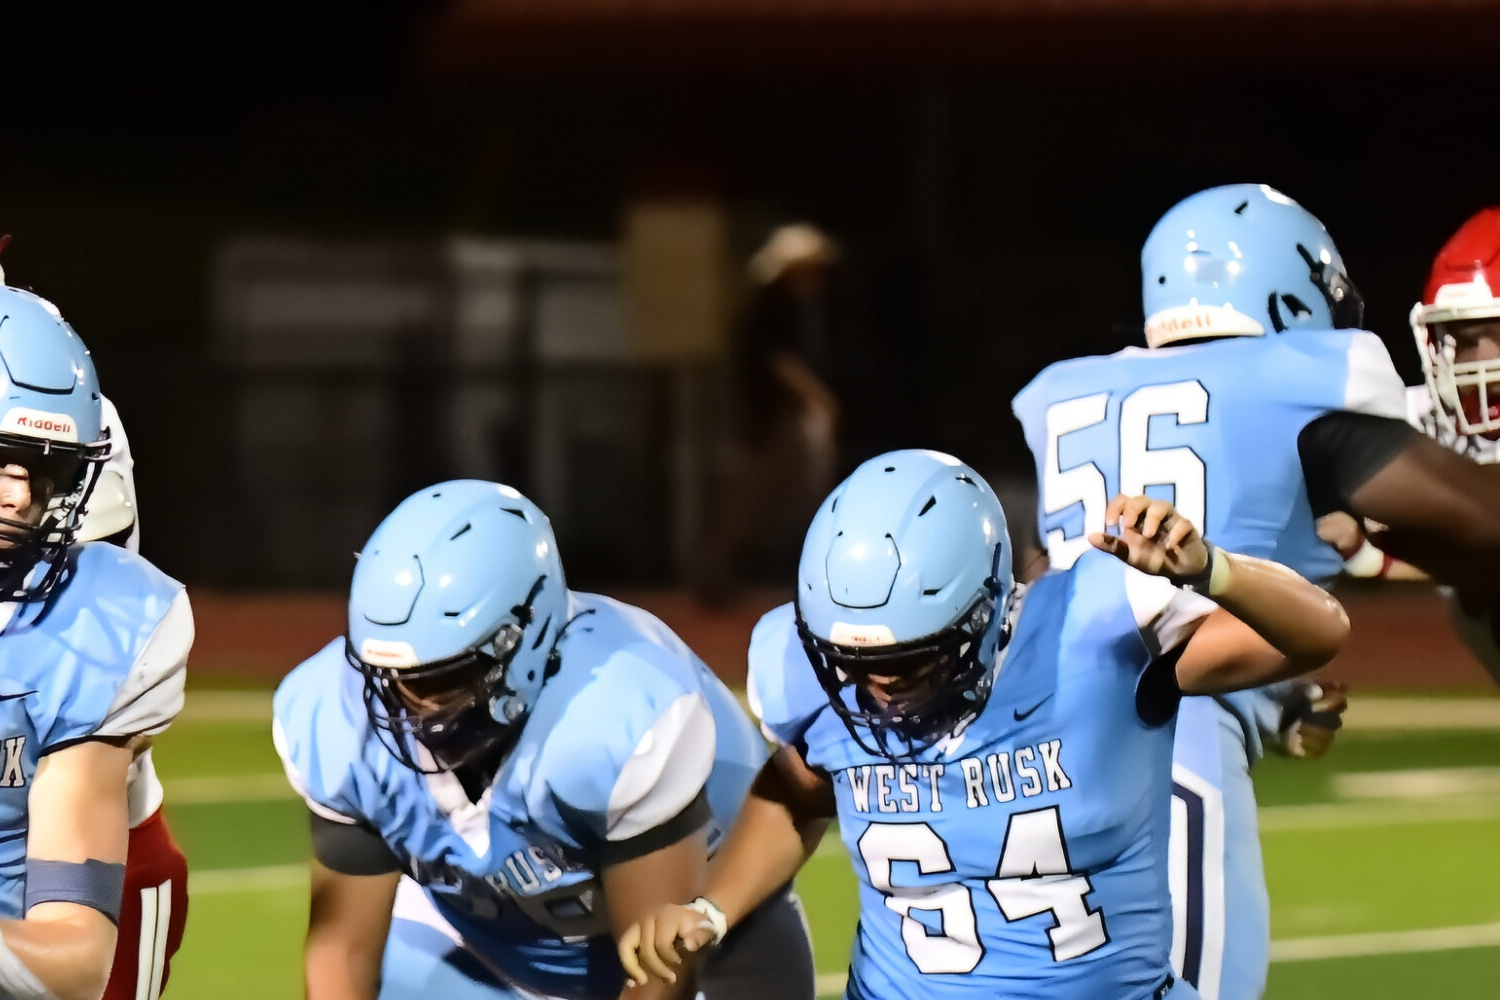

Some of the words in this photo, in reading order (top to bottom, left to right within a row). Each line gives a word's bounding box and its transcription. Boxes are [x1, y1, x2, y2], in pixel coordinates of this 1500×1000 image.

[17, 416, 71, 433] Riddell
[1043, 380, 1209, 570] 56
[846, 763, 945, 813] WEST
[960, 738, 1073, 809] RUSK
[857, 804, 1110, 975] 64
